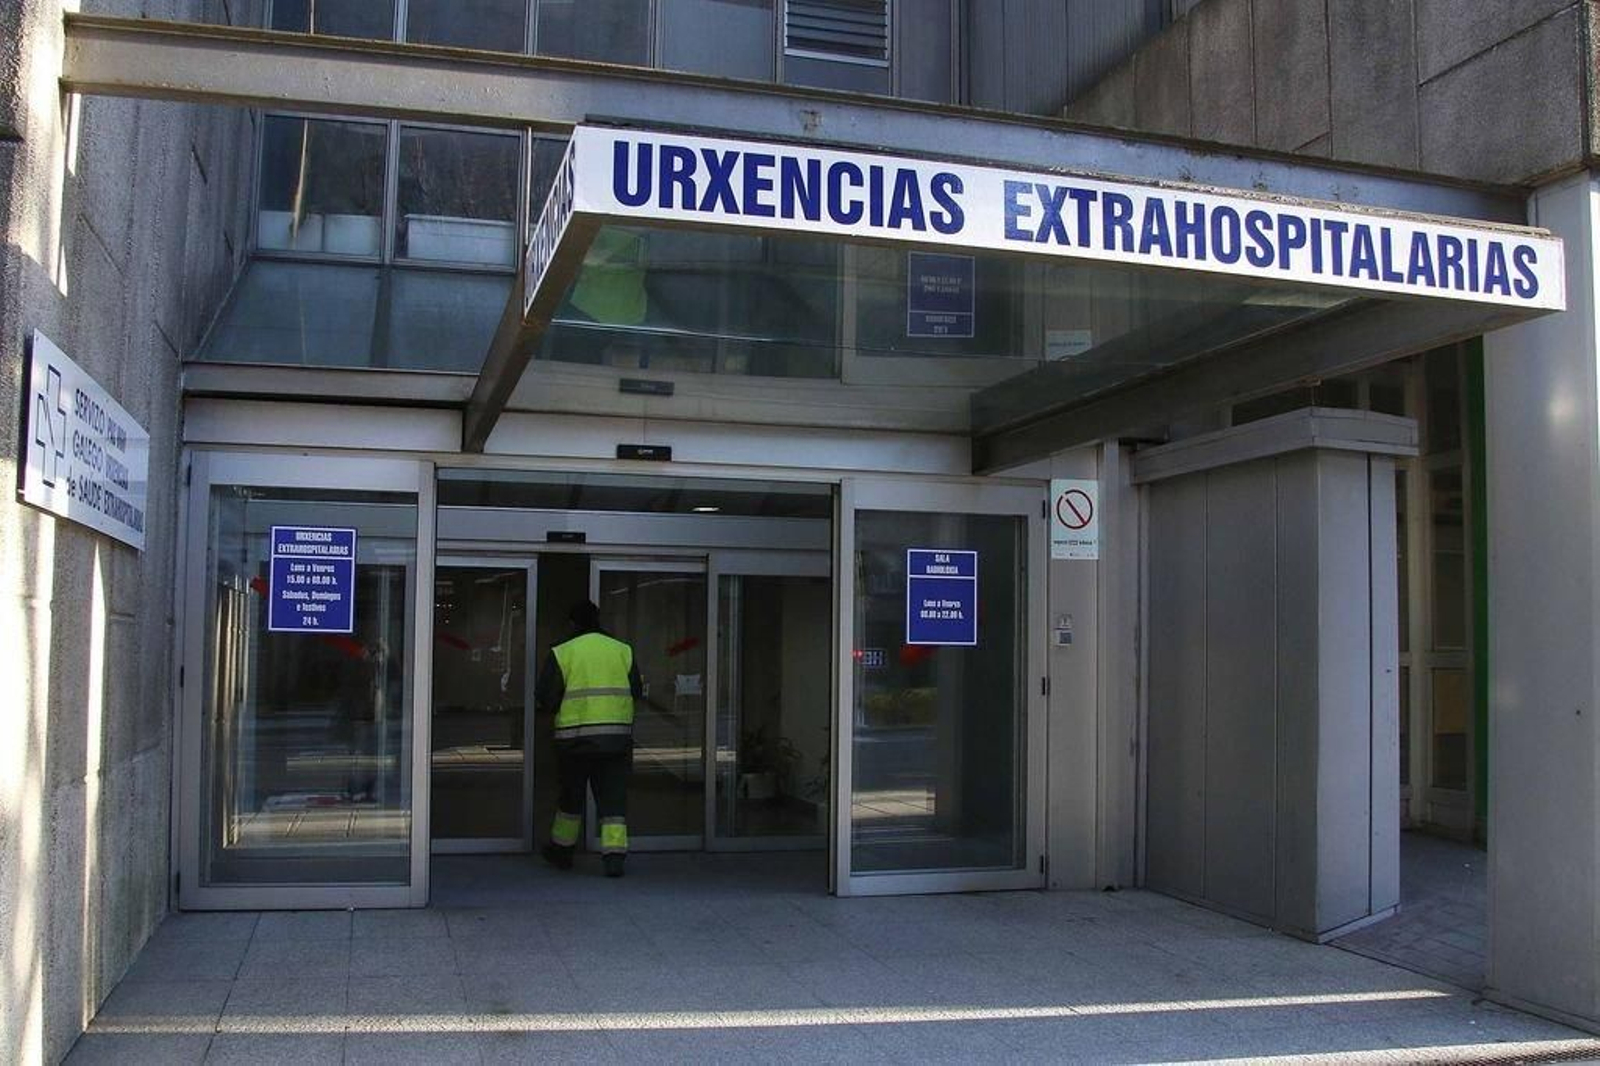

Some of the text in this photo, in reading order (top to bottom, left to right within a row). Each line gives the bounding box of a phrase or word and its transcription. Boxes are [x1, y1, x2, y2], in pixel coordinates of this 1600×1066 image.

[612, 140, 1538, 300] URXENCIAS EXTRAHOSPITALARIAS
[75, 388, 105, 435] SERVIZO
[73, 429, 104, 473] GALEGO
[67, 465, 76, 498] de
[302, 616, 312, 625] 24
